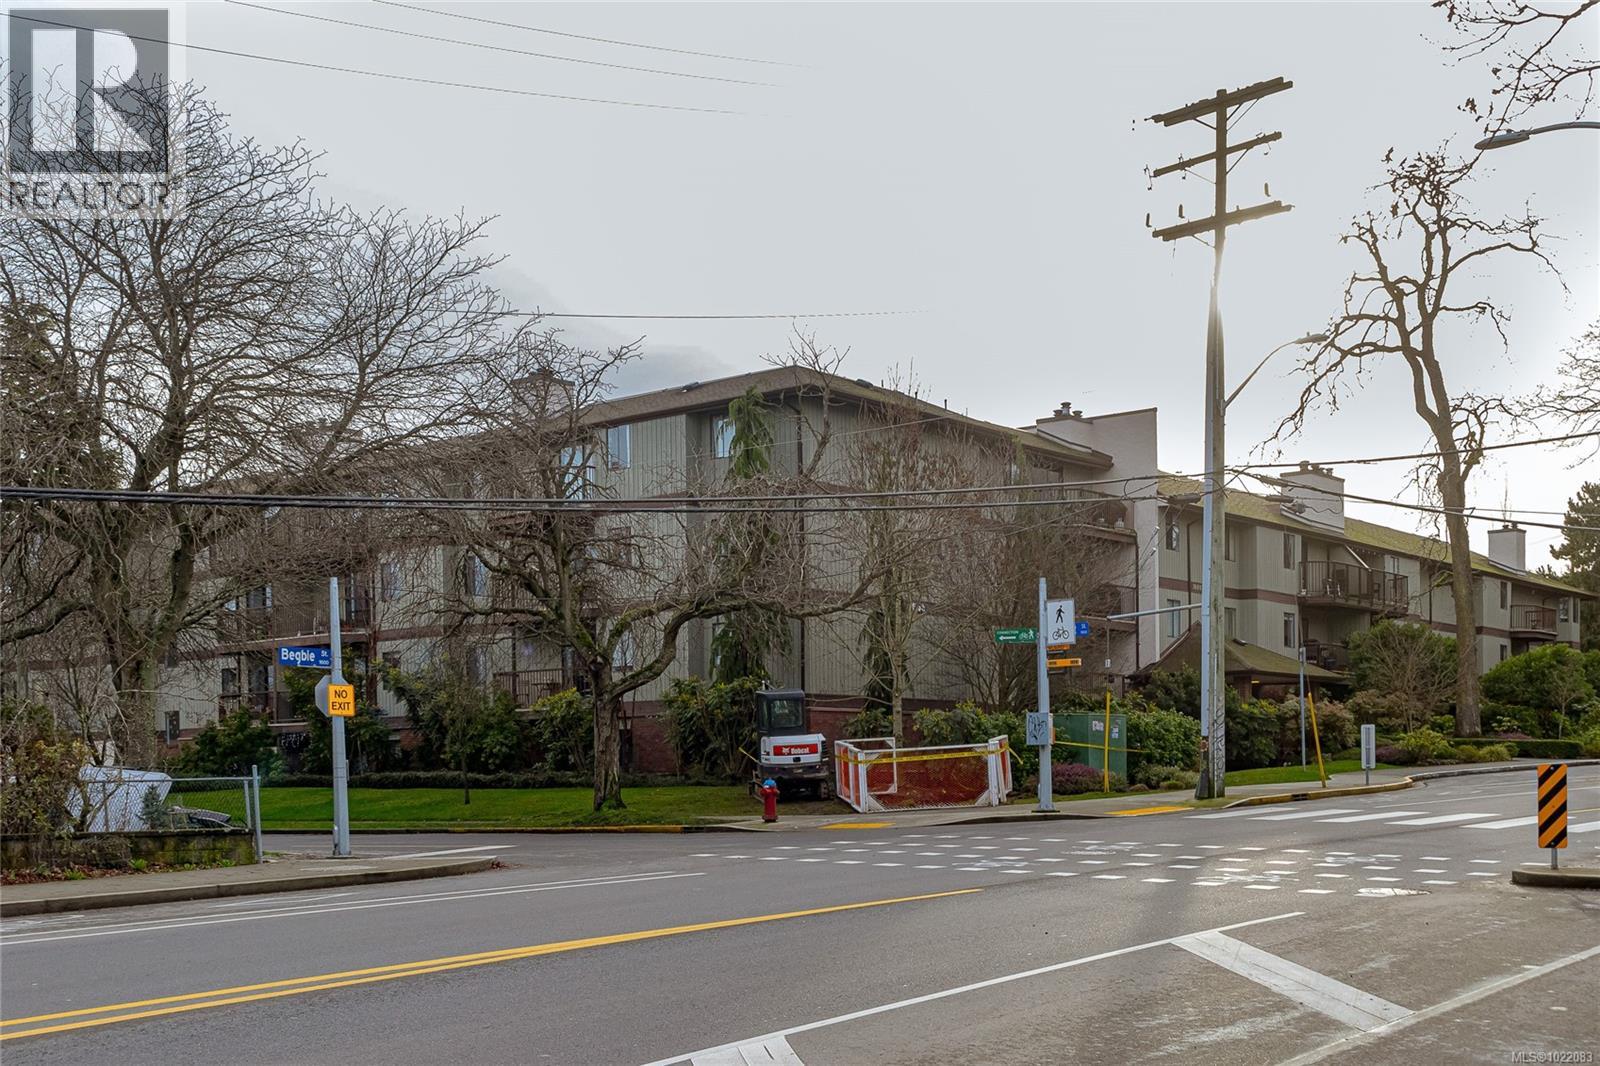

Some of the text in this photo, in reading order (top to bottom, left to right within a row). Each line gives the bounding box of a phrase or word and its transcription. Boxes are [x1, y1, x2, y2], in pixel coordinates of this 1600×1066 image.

[281, 648, 316, 664] Begbie
[334, 690, 348, 698] NO
[331, 702, 351, 711] EXIT
